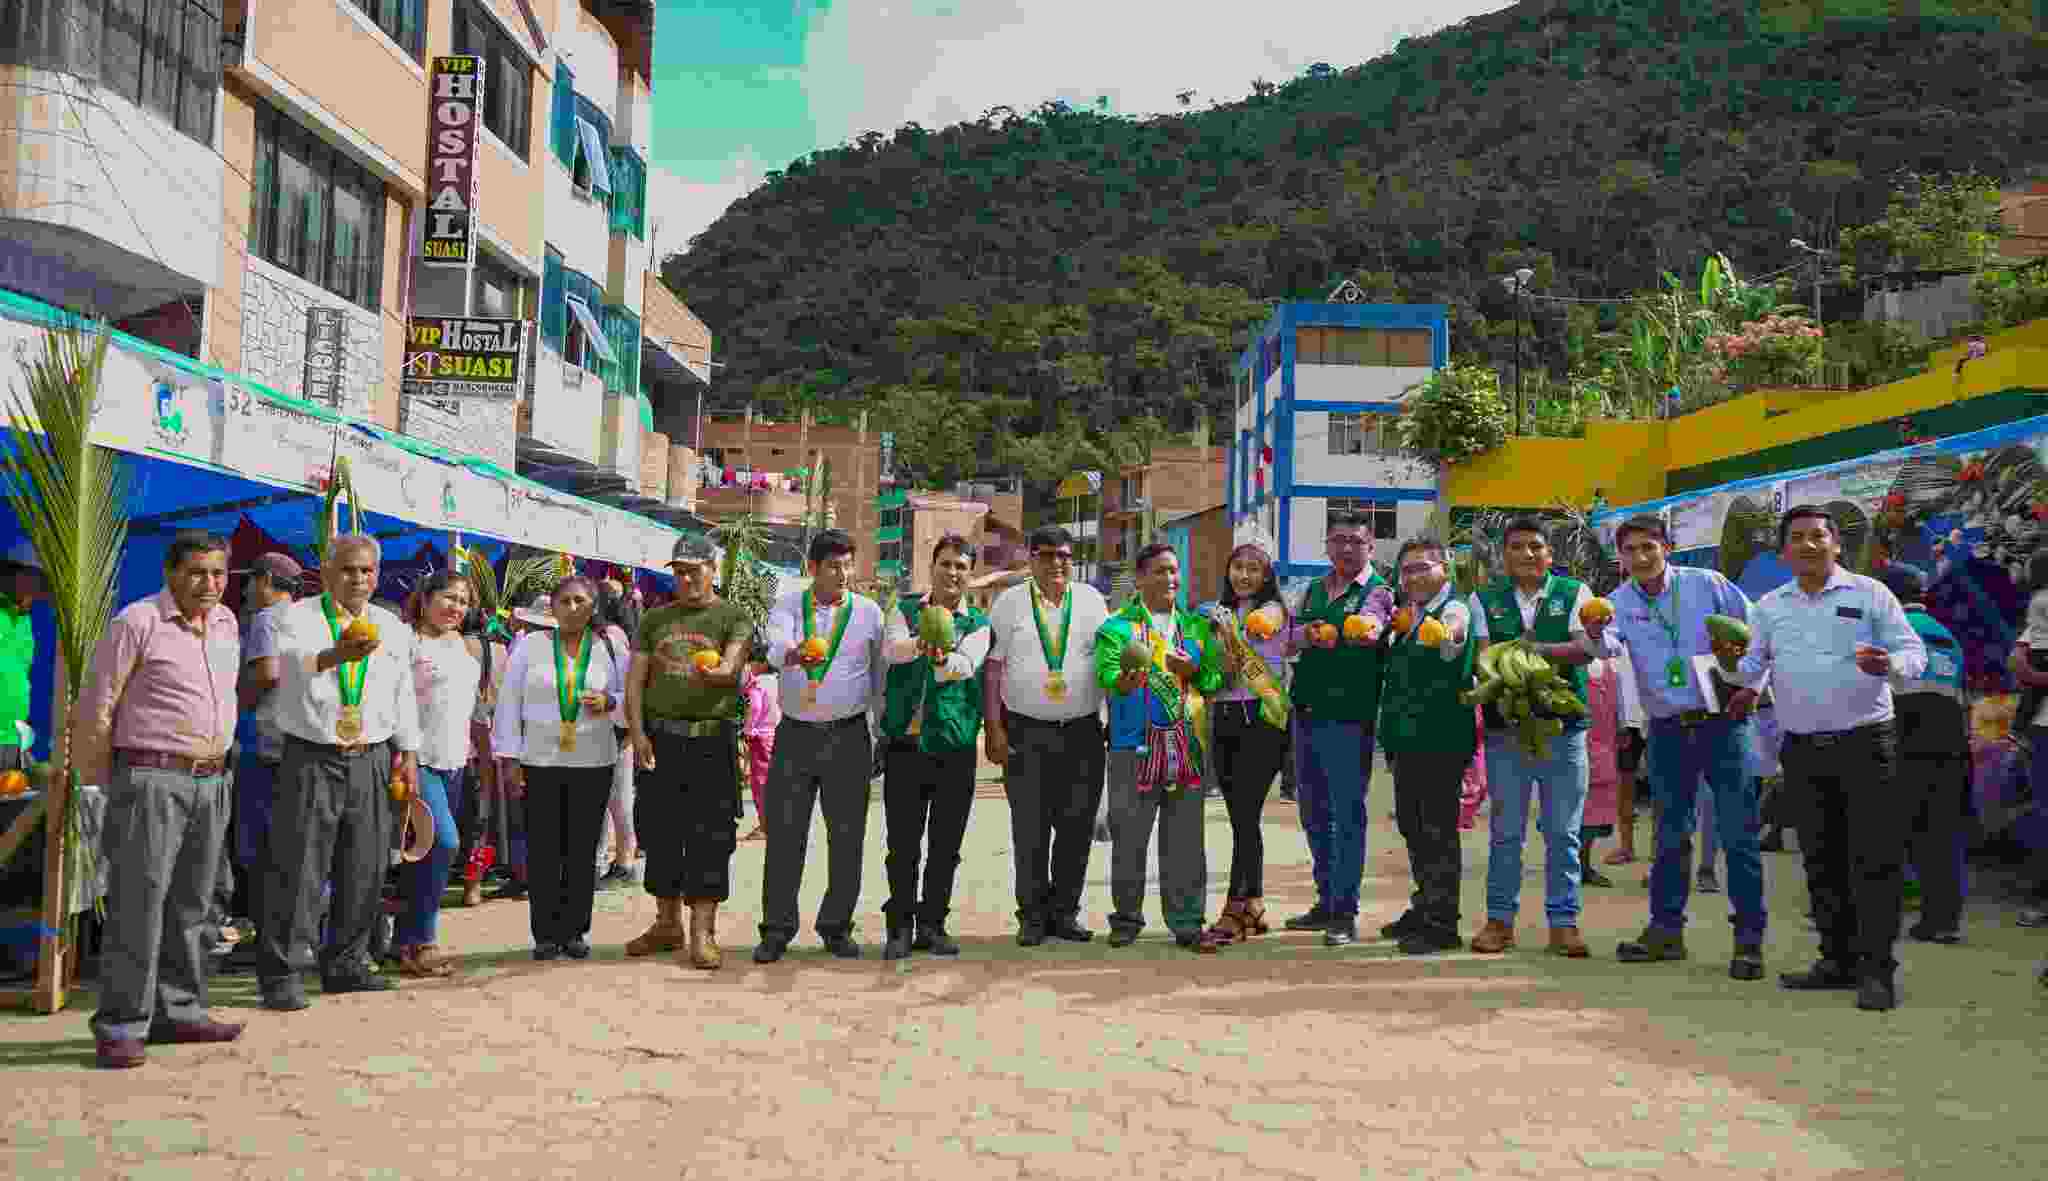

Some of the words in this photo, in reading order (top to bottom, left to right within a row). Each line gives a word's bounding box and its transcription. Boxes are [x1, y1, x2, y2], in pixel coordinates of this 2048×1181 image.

[439, 57, 473, 73] VIP
[432, 74, 475, 238] HOSTAL
[425, 239, 466, 257] SUASI
[411, 327, 441, 345] VIP
[439, 353, 513, 377] SUASI
